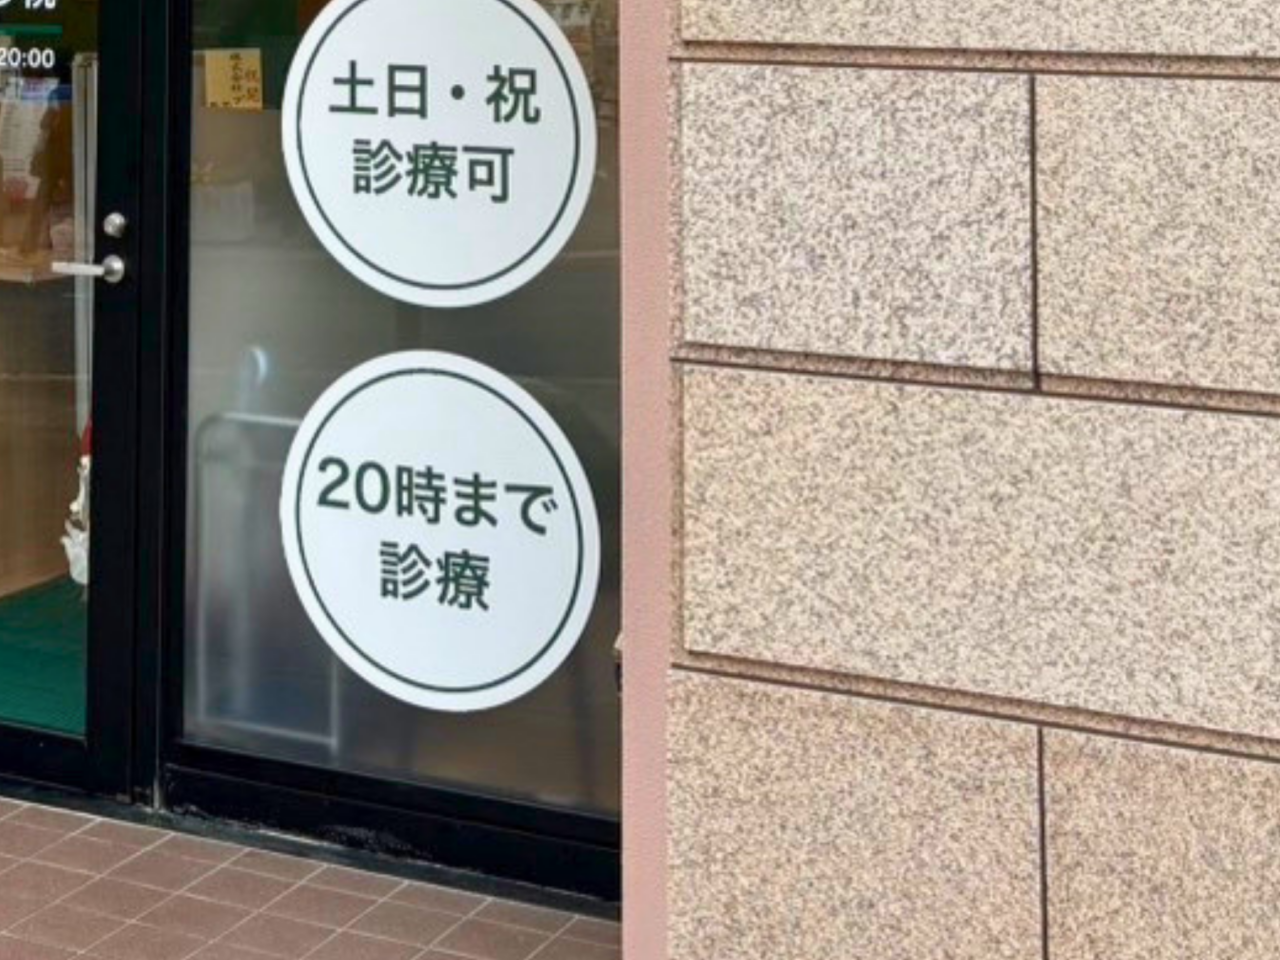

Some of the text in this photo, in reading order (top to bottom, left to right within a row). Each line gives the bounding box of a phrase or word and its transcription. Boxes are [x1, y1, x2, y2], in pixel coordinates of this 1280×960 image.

[328, 59, 541, 124] 土日・祝
[352, 139, 515, 203] 診療可
[317, 456, 559, 536] 20時まで
[379, 541, 491, 612] 診療
